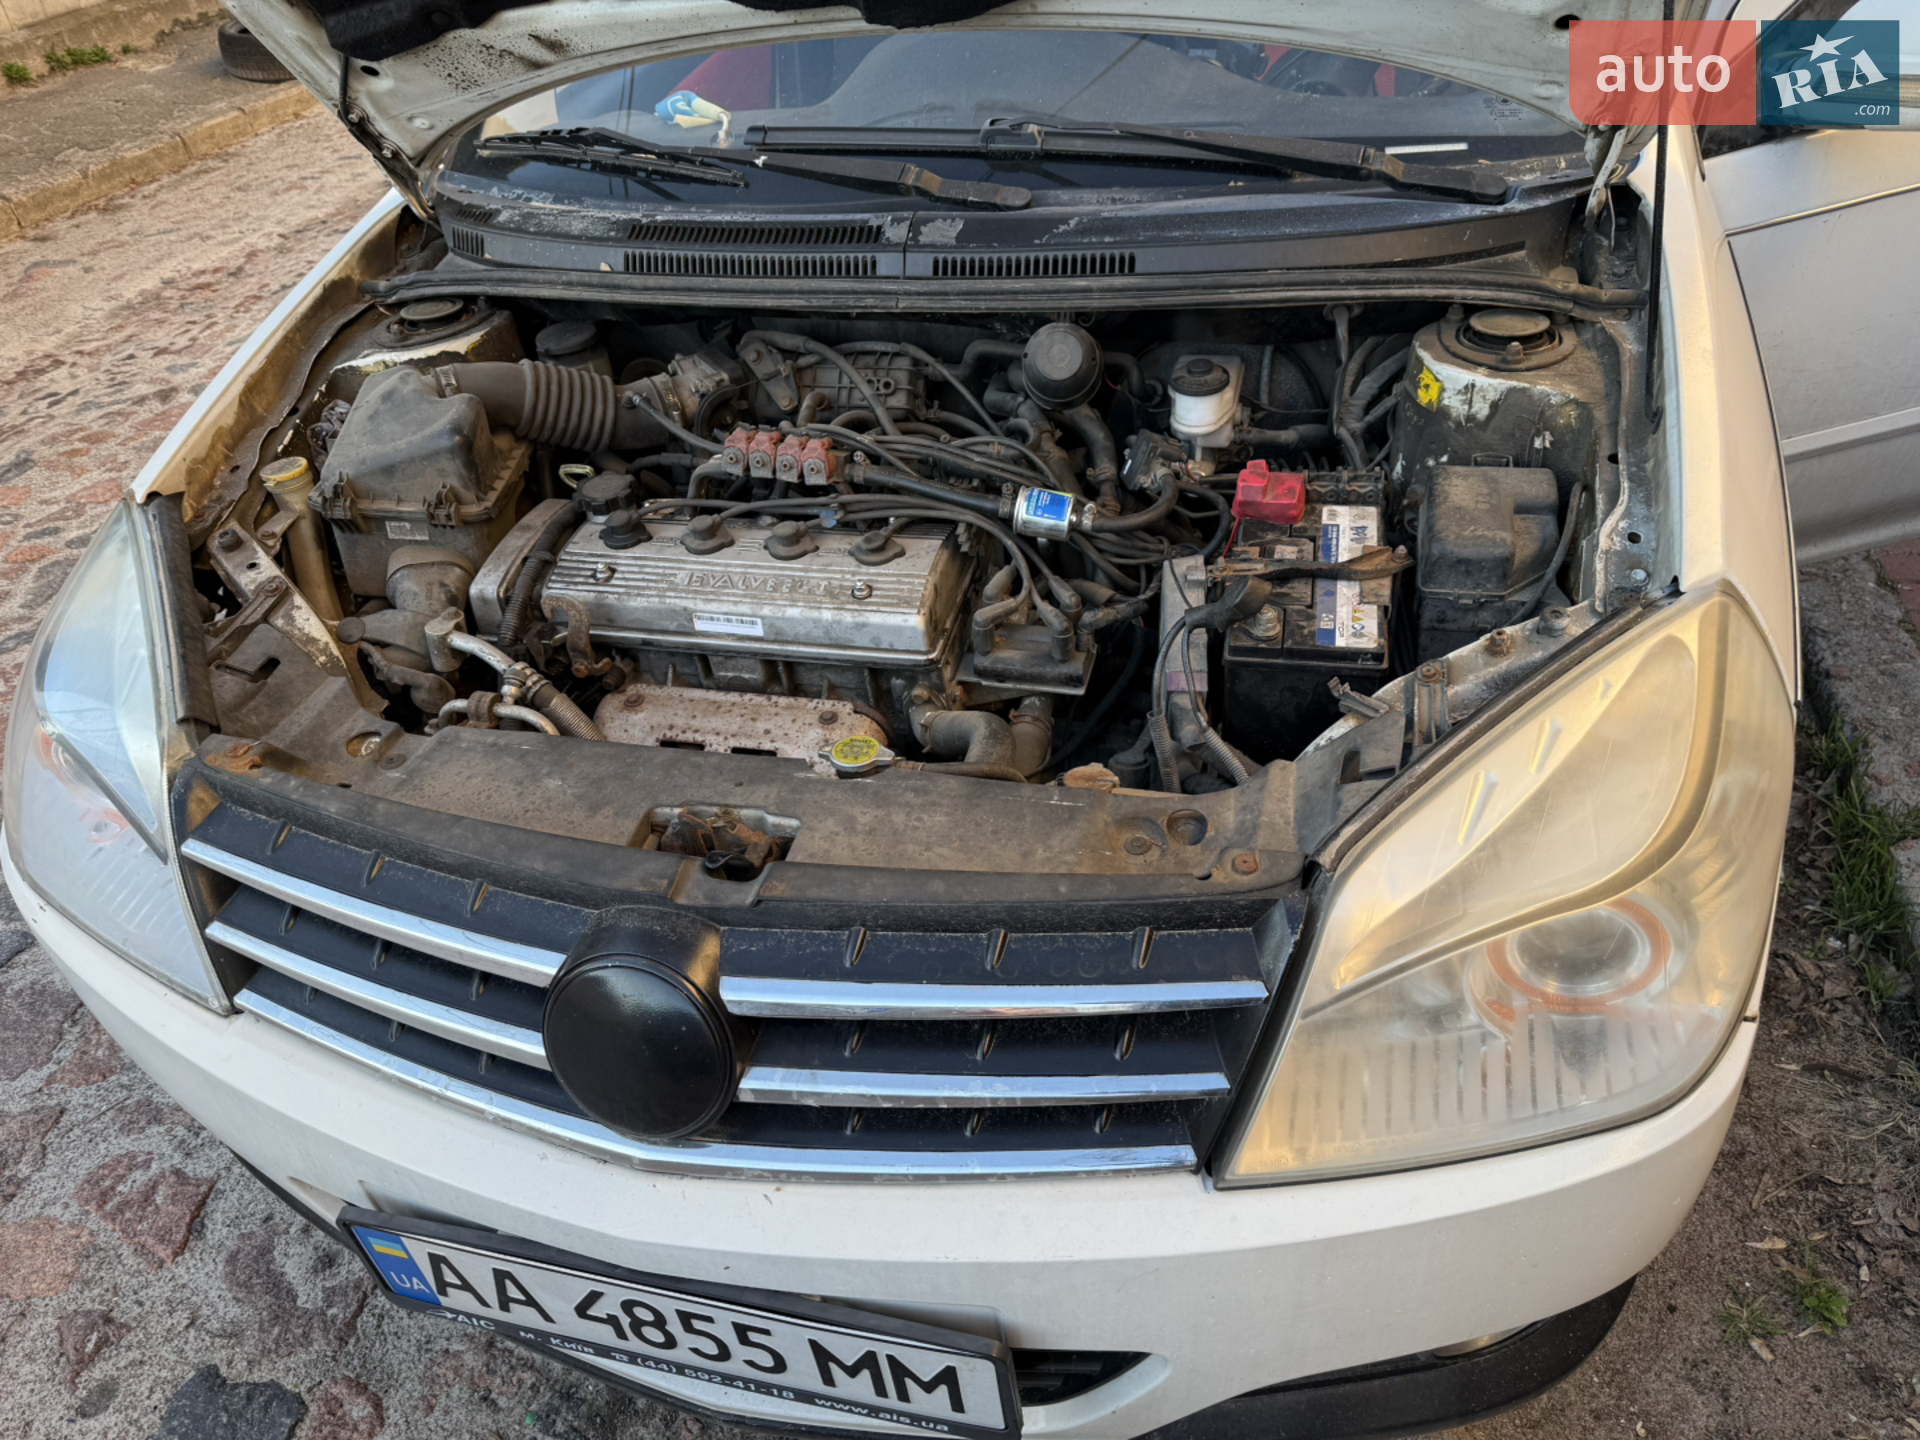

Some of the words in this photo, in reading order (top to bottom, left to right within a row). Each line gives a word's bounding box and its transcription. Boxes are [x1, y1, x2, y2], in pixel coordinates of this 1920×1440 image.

[389, 1270, 430, 1294] UA
[427, 1251, 557, 1325] AA
[573, 1289, 788, 1375] 4855
[808, 1337, 966, 1414] MM
[636, 1357, 677, 1374] (44)
[684, 1368, 796, 1400] 592-41-18
[814, 1398, 949, 1432] www.ais.ua
